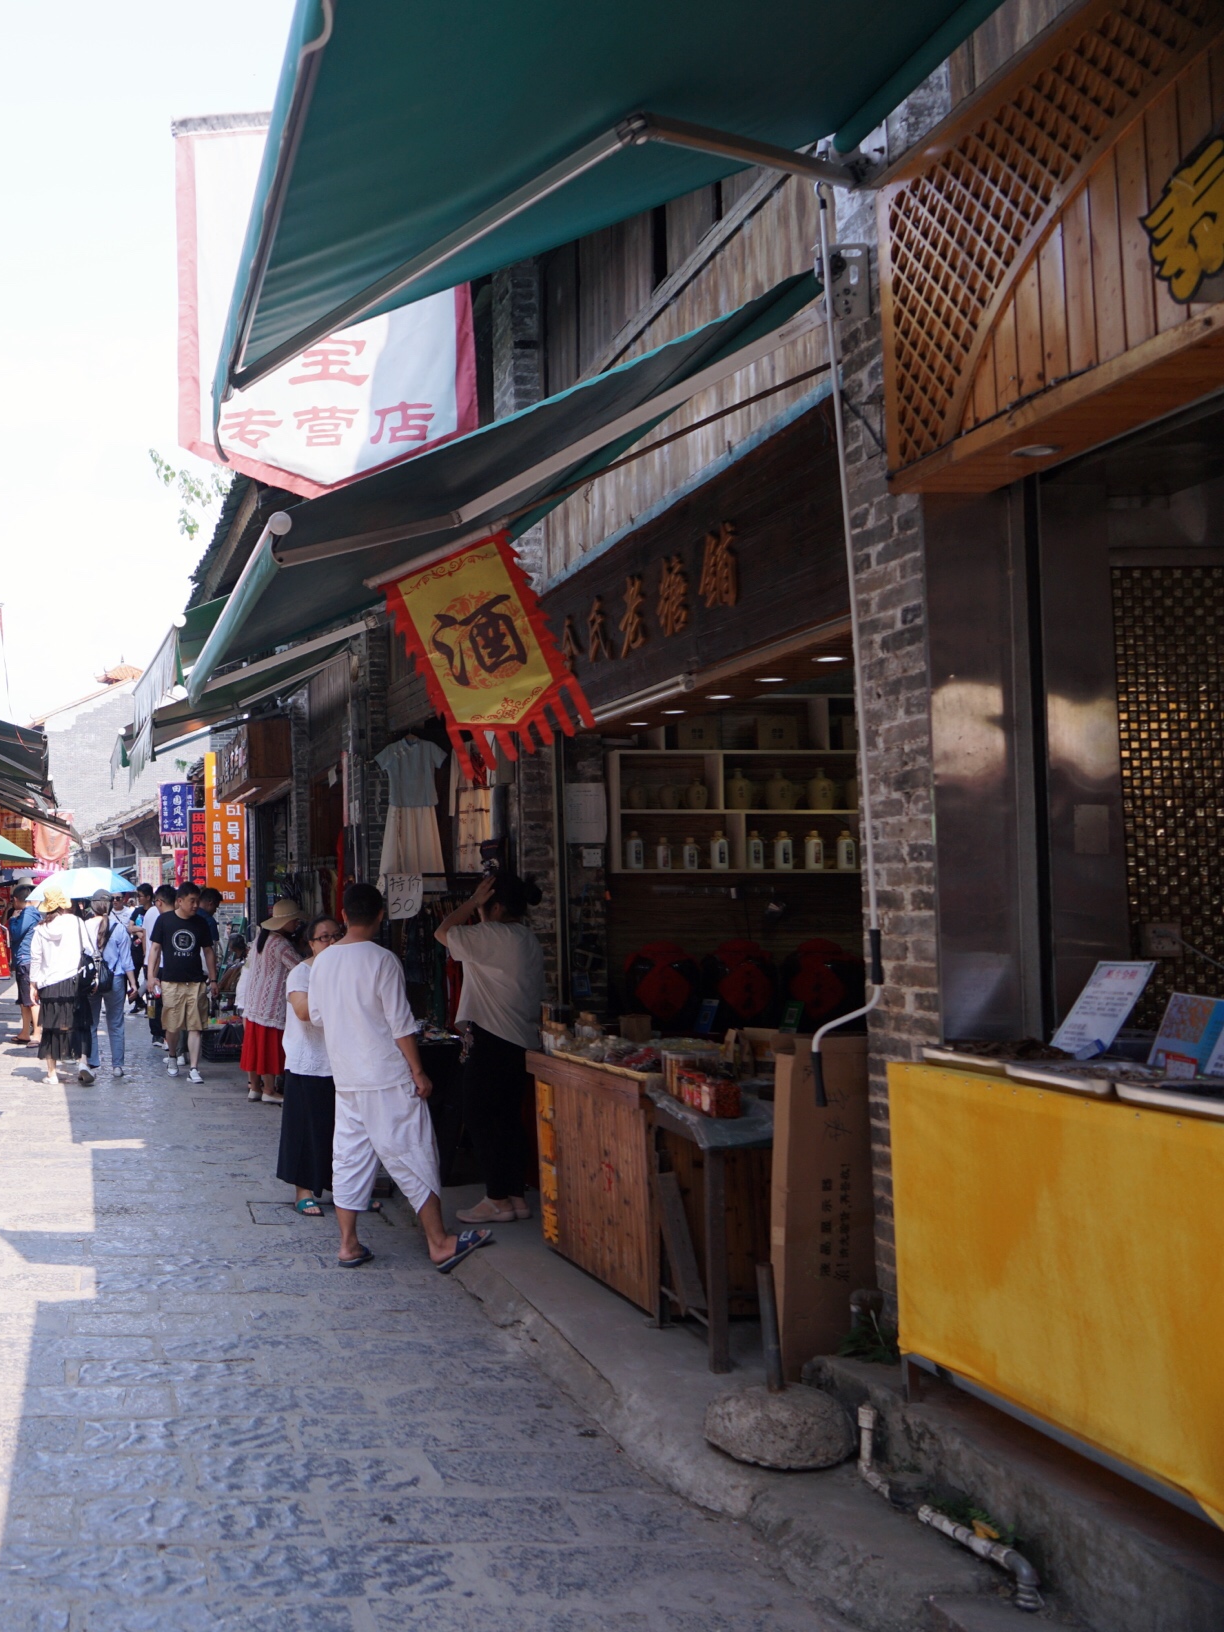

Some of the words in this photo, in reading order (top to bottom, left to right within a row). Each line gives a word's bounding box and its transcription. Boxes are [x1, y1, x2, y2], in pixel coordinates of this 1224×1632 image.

[221, 401, 435, 448] 专营店
[432, 595, 529, 686] 酒
[226, 804, 242, 882] 61号餐吧
[389, 875, 422, 892] 特价
